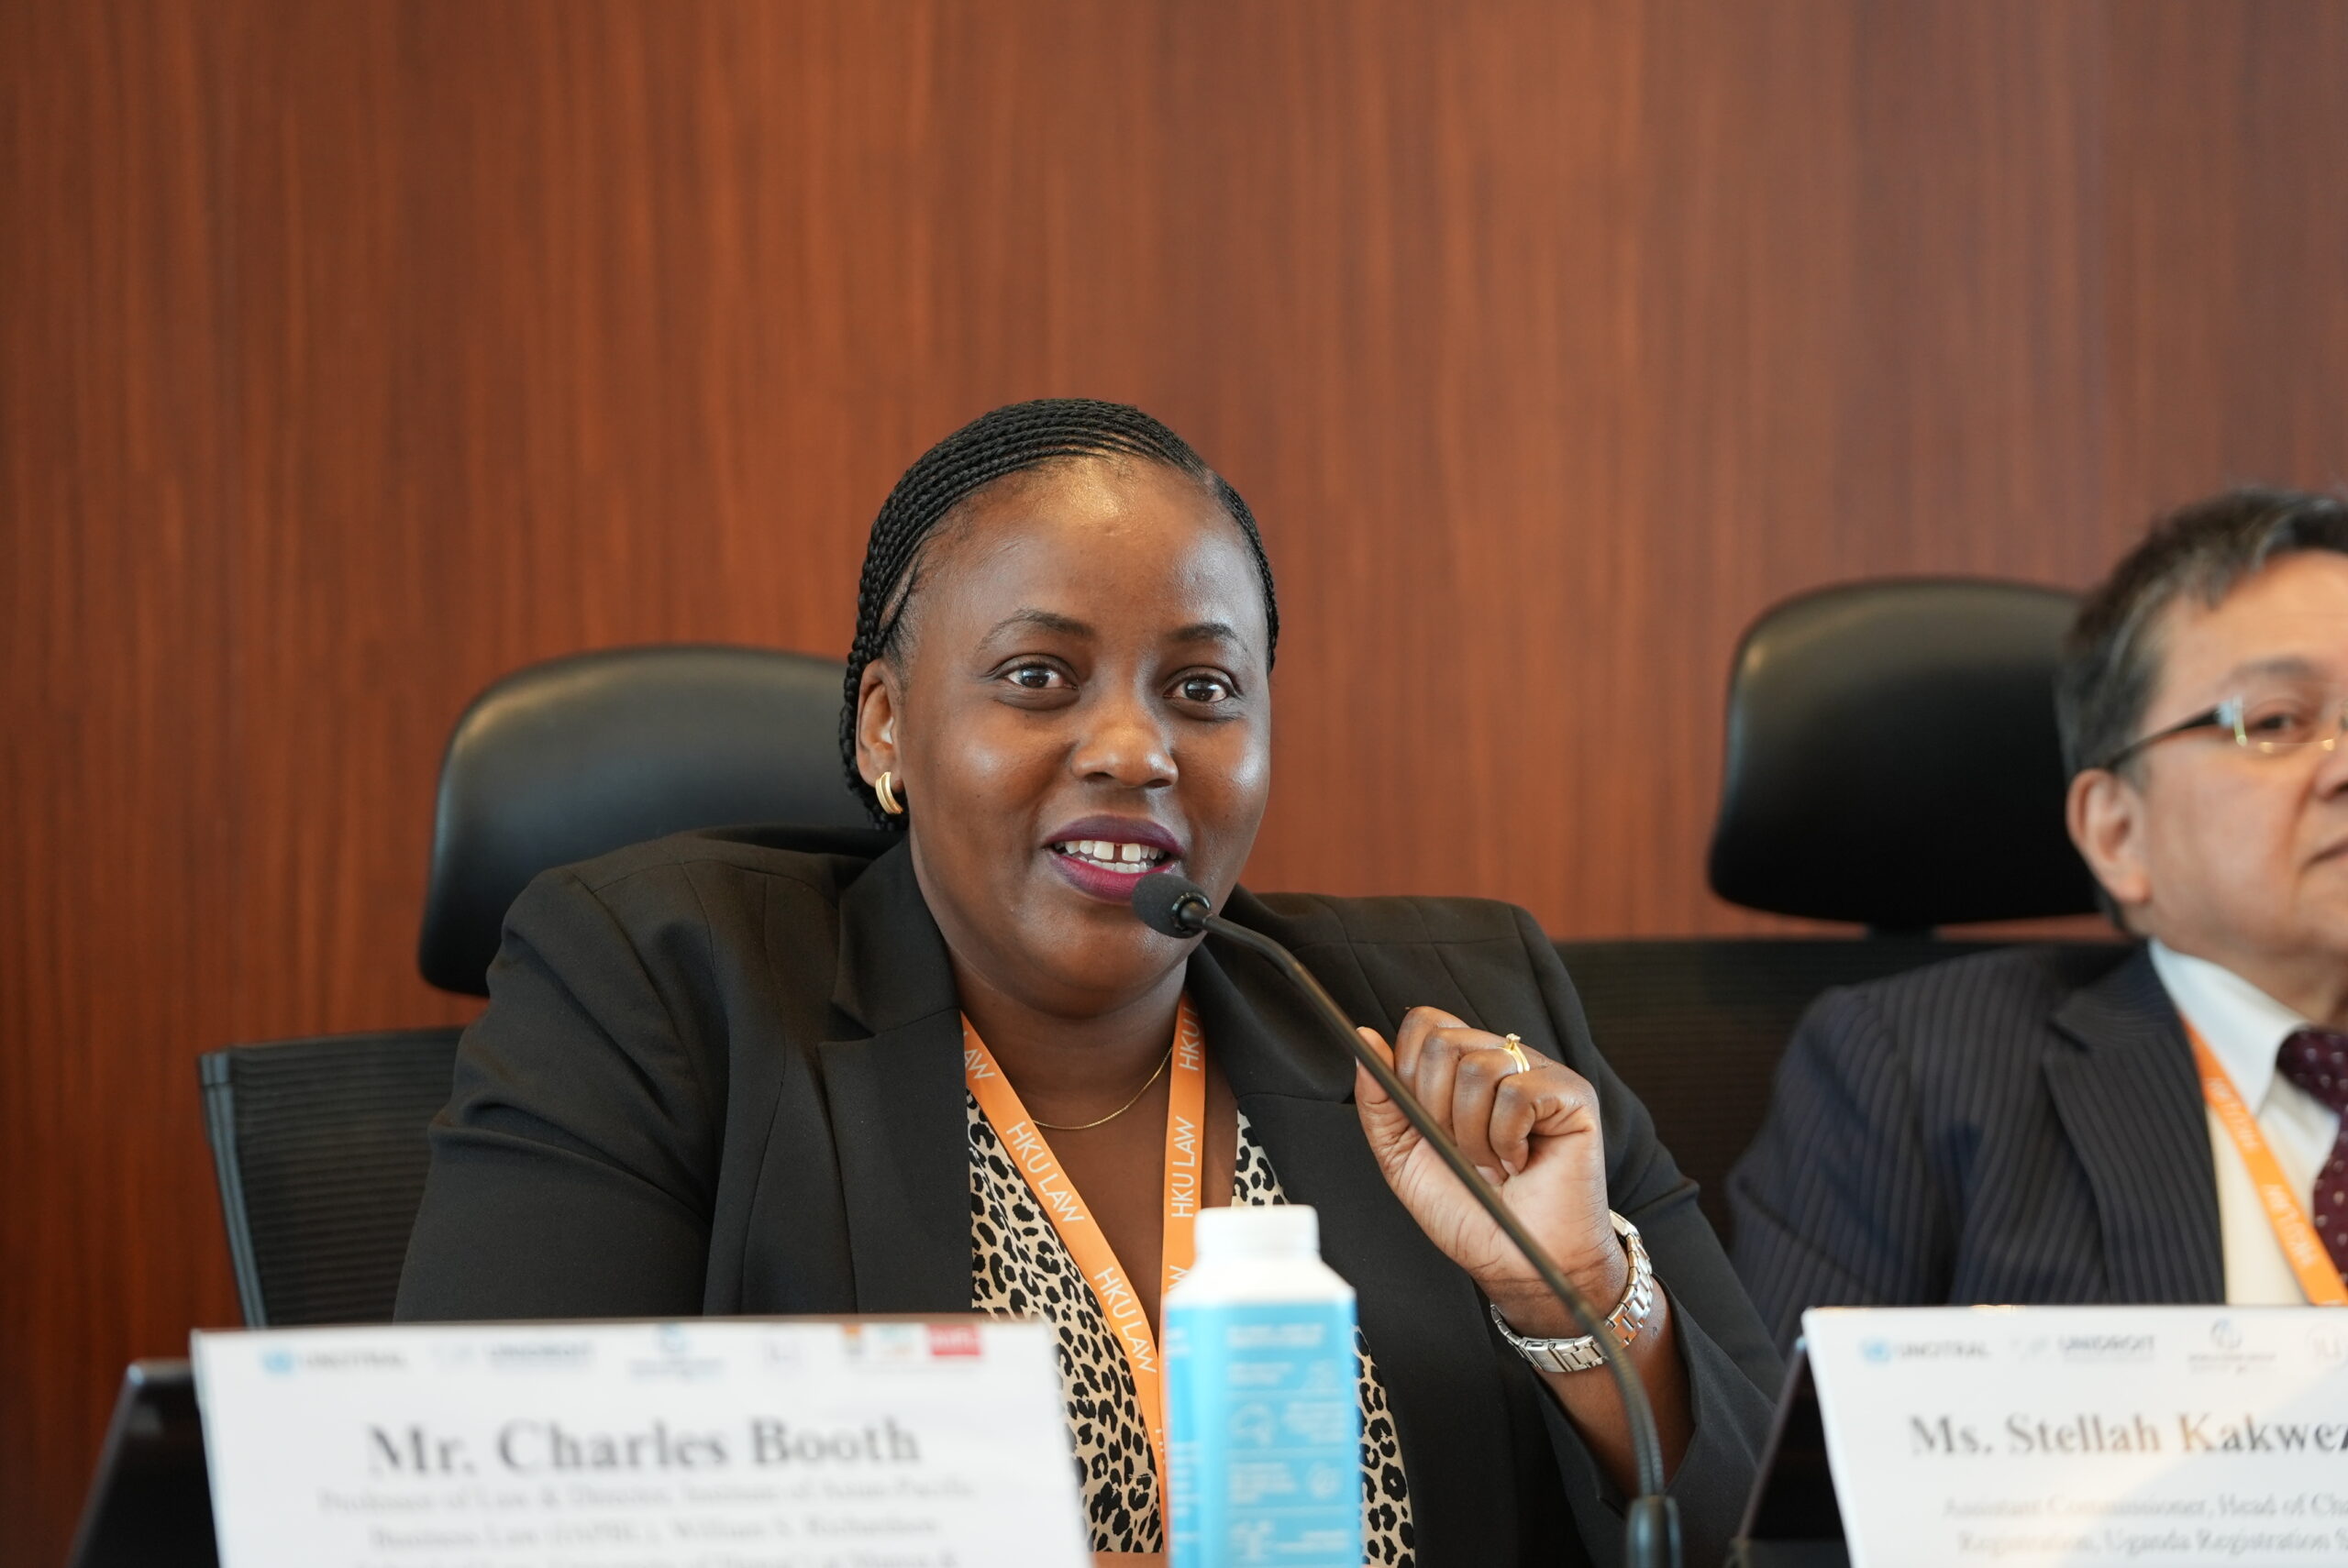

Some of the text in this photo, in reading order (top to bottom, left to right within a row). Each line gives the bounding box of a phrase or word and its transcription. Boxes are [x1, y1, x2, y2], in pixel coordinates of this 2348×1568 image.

[1179, 1018, 1200, 1072] HKU
[1006, 1121, 1086, 1223] HKU LAW
[1170, 1115, 1196, 1218] HKU LAW
[1093, 1266, 1157, 1375] HKU LAW
[370, 1417, 922, 1476] Mr. Charles Booth
[1909, 1415, 1994, 1456] Ms.
[2006, 1413, 2162, 1455] Stellah
